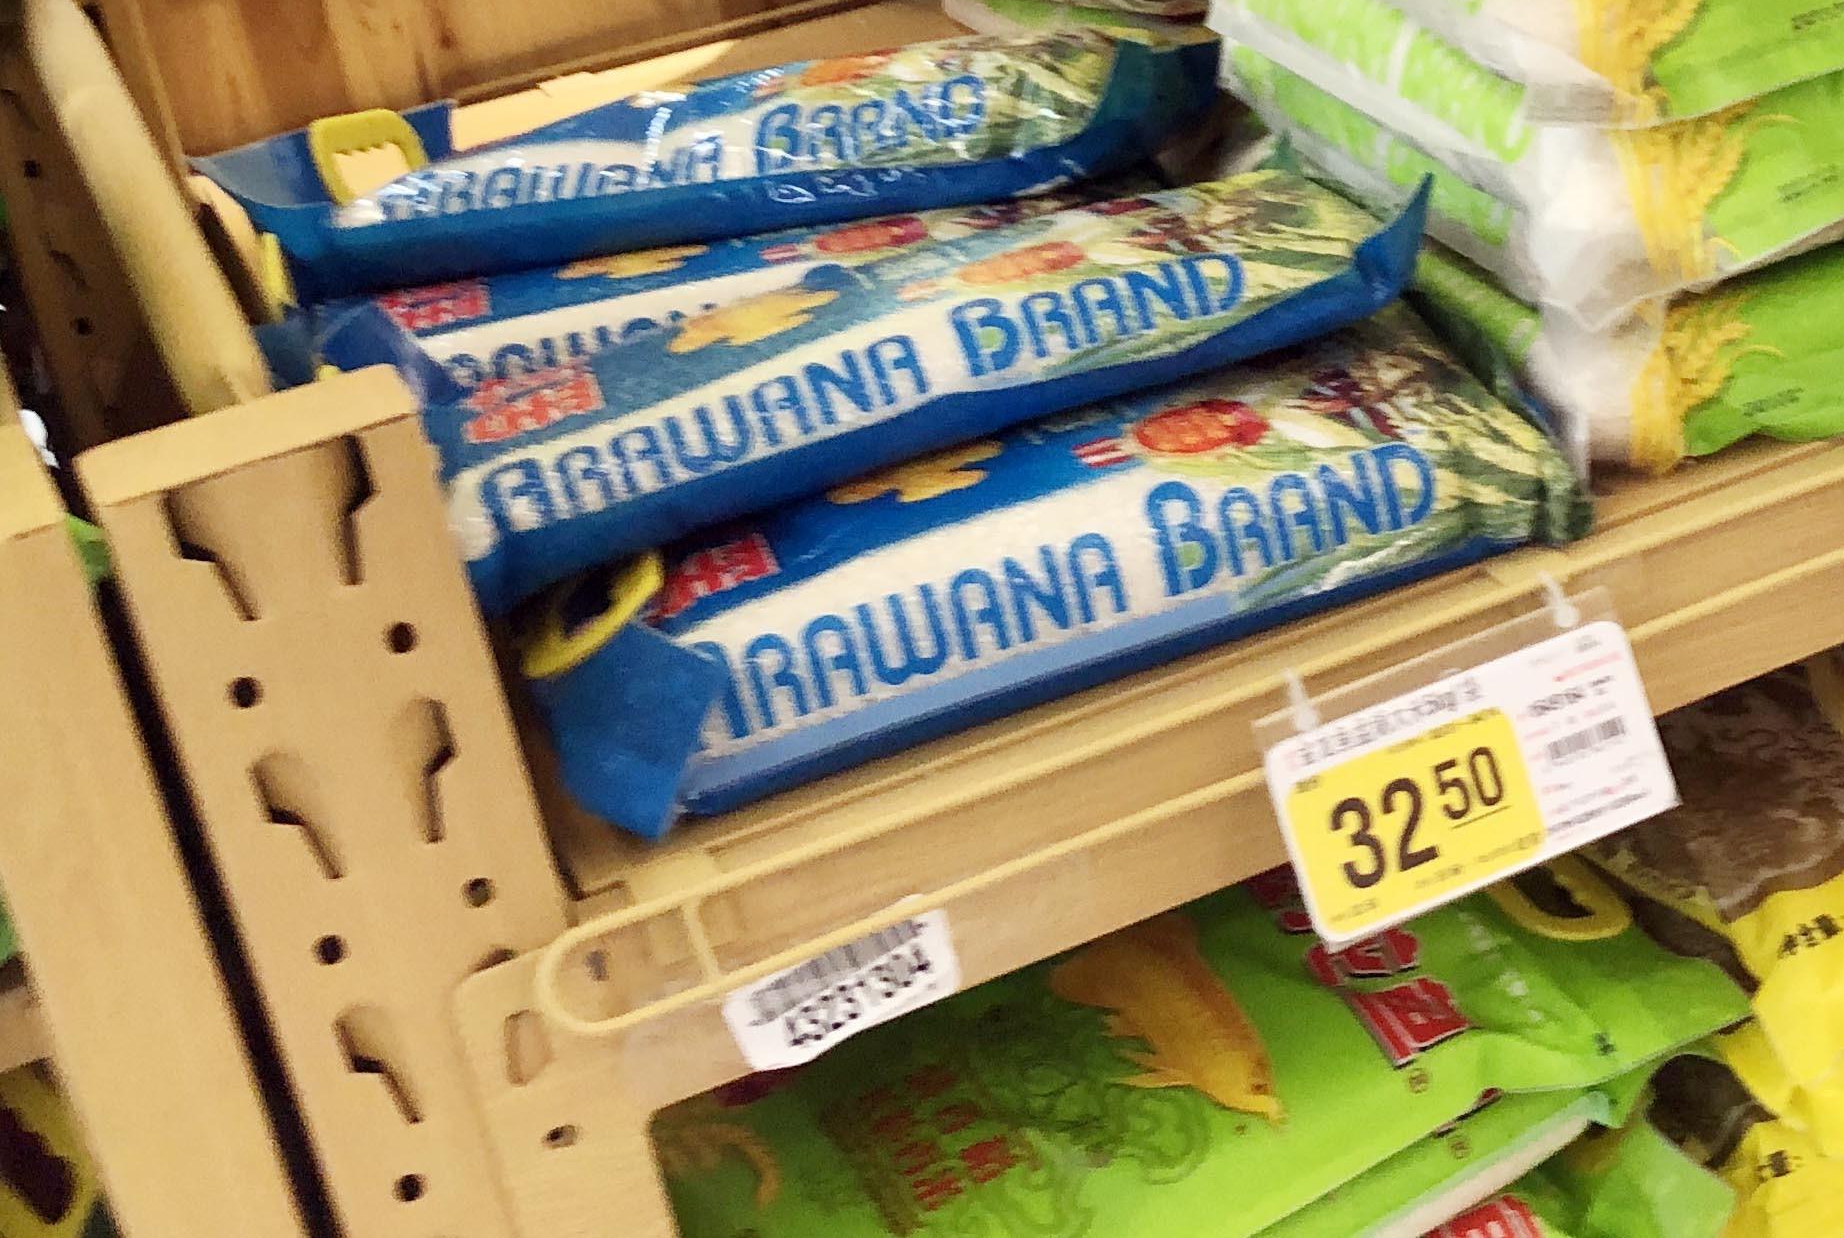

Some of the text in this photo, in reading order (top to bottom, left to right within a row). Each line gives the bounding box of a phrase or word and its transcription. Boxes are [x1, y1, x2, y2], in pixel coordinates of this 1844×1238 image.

[478, 335, 931, 537] ARAWANA
[949, 252, 1246, 378] BRAND
[1143, 441, 1437, 597] BRAND
